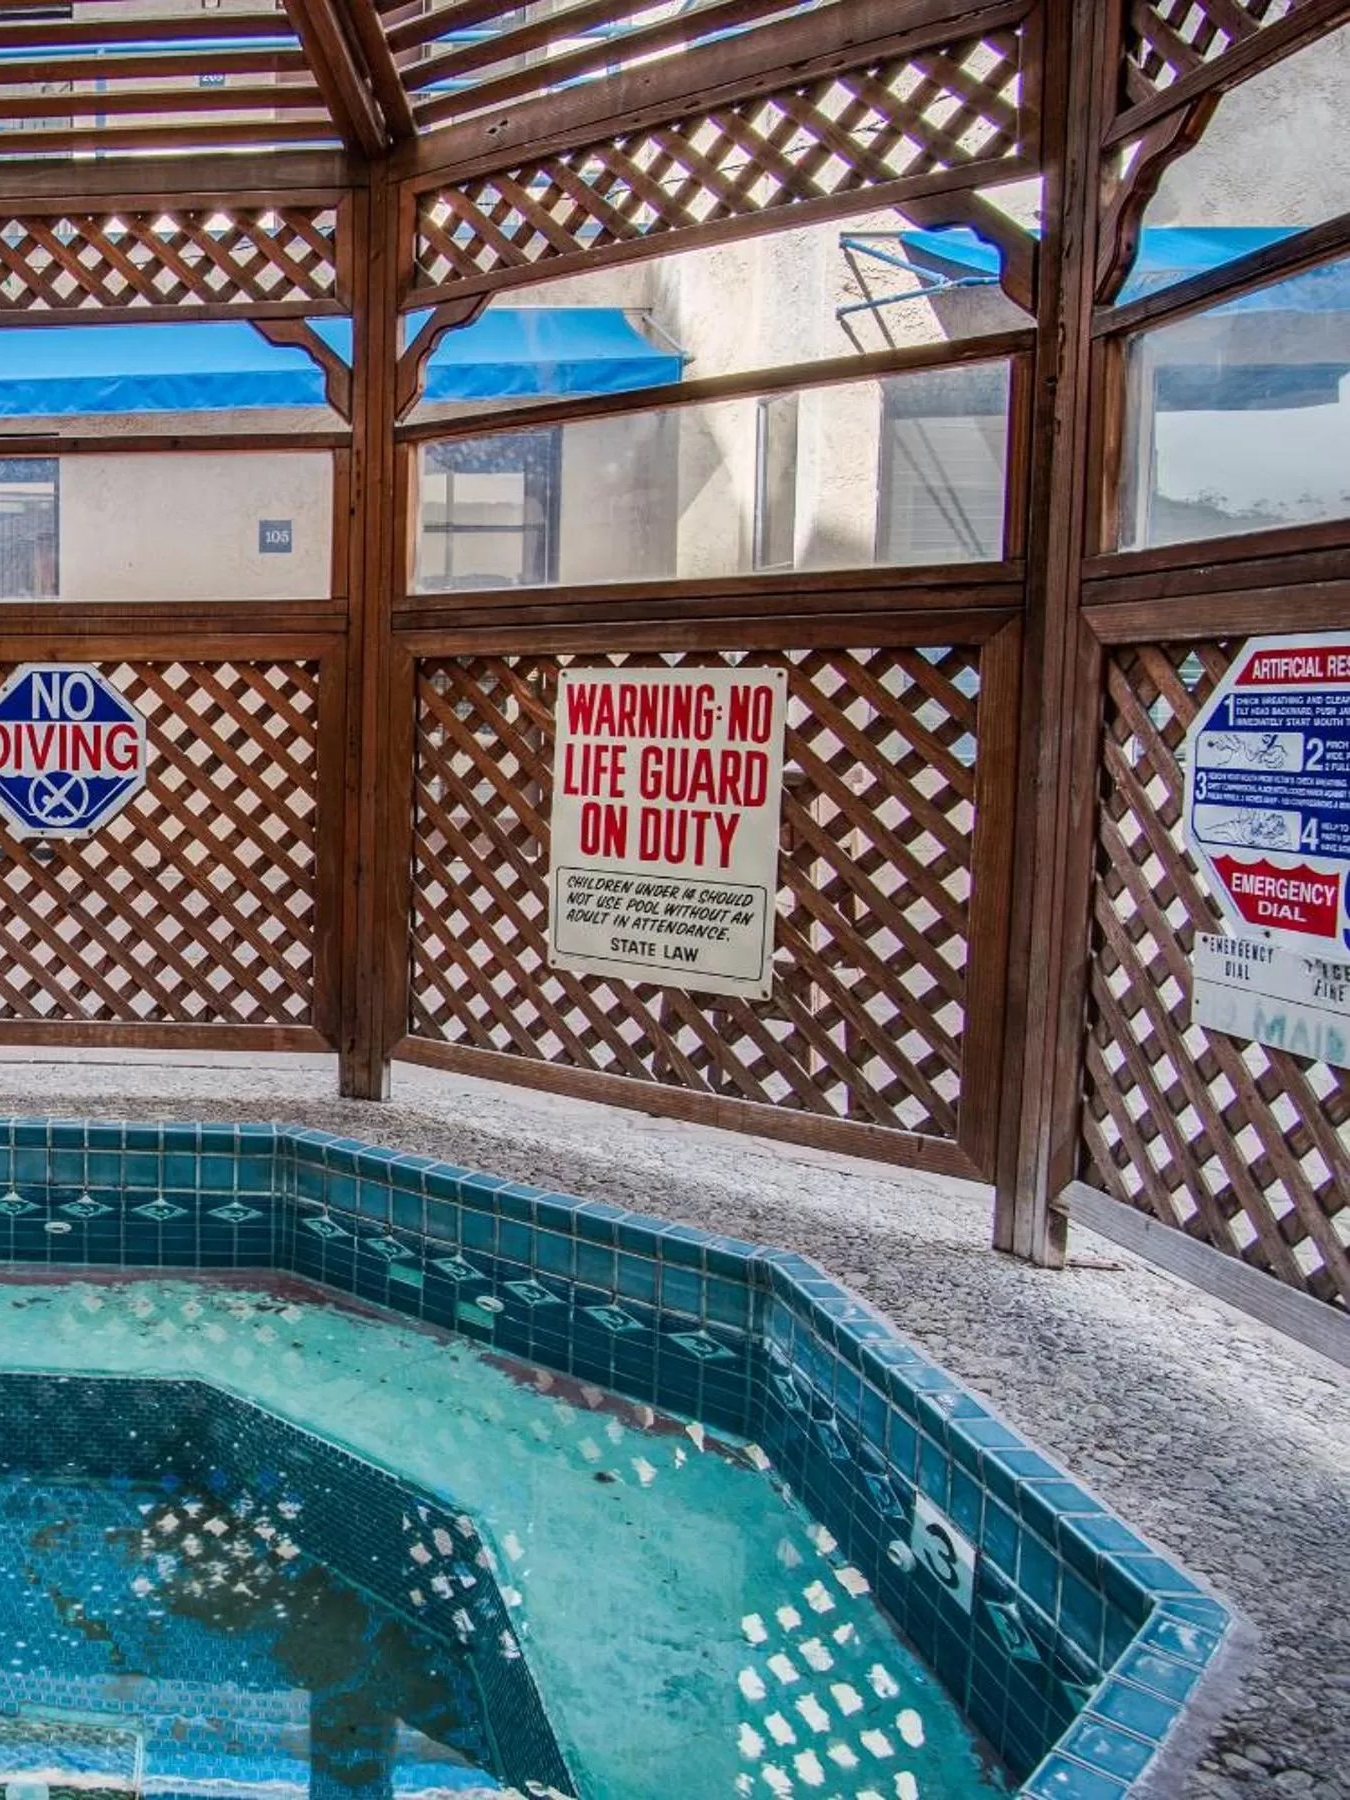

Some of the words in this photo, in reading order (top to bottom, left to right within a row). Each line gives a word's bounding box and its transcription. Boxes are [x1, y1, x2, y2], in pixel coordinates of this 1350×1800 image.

[266, 530, 290, 544] 105
[1252, 657, 1323, 679] ARTIFICIAL
[31, 672, 95, 721] NO
[566, 683, 723, 741] WARNING:
[728, 685, 773, 743] NO
[1224, 694, 1234, 726] 1
[1306, 737, 1324, 771] 2
[563, 743, 627, 798] LIFE
[639, 745, 768, 807] GUARD
[1195, 771, 1207, 800] 3
[580, 802, 628, 859] ON
[639, 807, 740, 868] DUTY
[1301, 816, 1319, 851] 4
[567, 875, 633, 894] CHILDREN
[635, 882, 680, 899] UNDER
[698, 889, 754, 907] SHOULD
[1231, 872, 1337, 907] EMERGENCY
[566, 891, 594, 906] NOT
[597, 895, 622, 910] USE
[626, 898, 660, 915] POOL
[663, 902, 730, 923] WITHOUT
[730, 911, 754, 927] AN
[566, 908, 608, 925] ADULT
[613, 914, 629, 928] IN
[631, 916, 730, 942] ATTENDANCE.
[1258, 902, 1308, 922] DIAL
[610, 937, 656, 958] STATE
[663, 944, 700, 963] LAW
[1210, 937, 1274, 964] EMERGENCY
[1224, 961, 1251, 981] DIAL
[923, 1523, 960, 1590] 3
